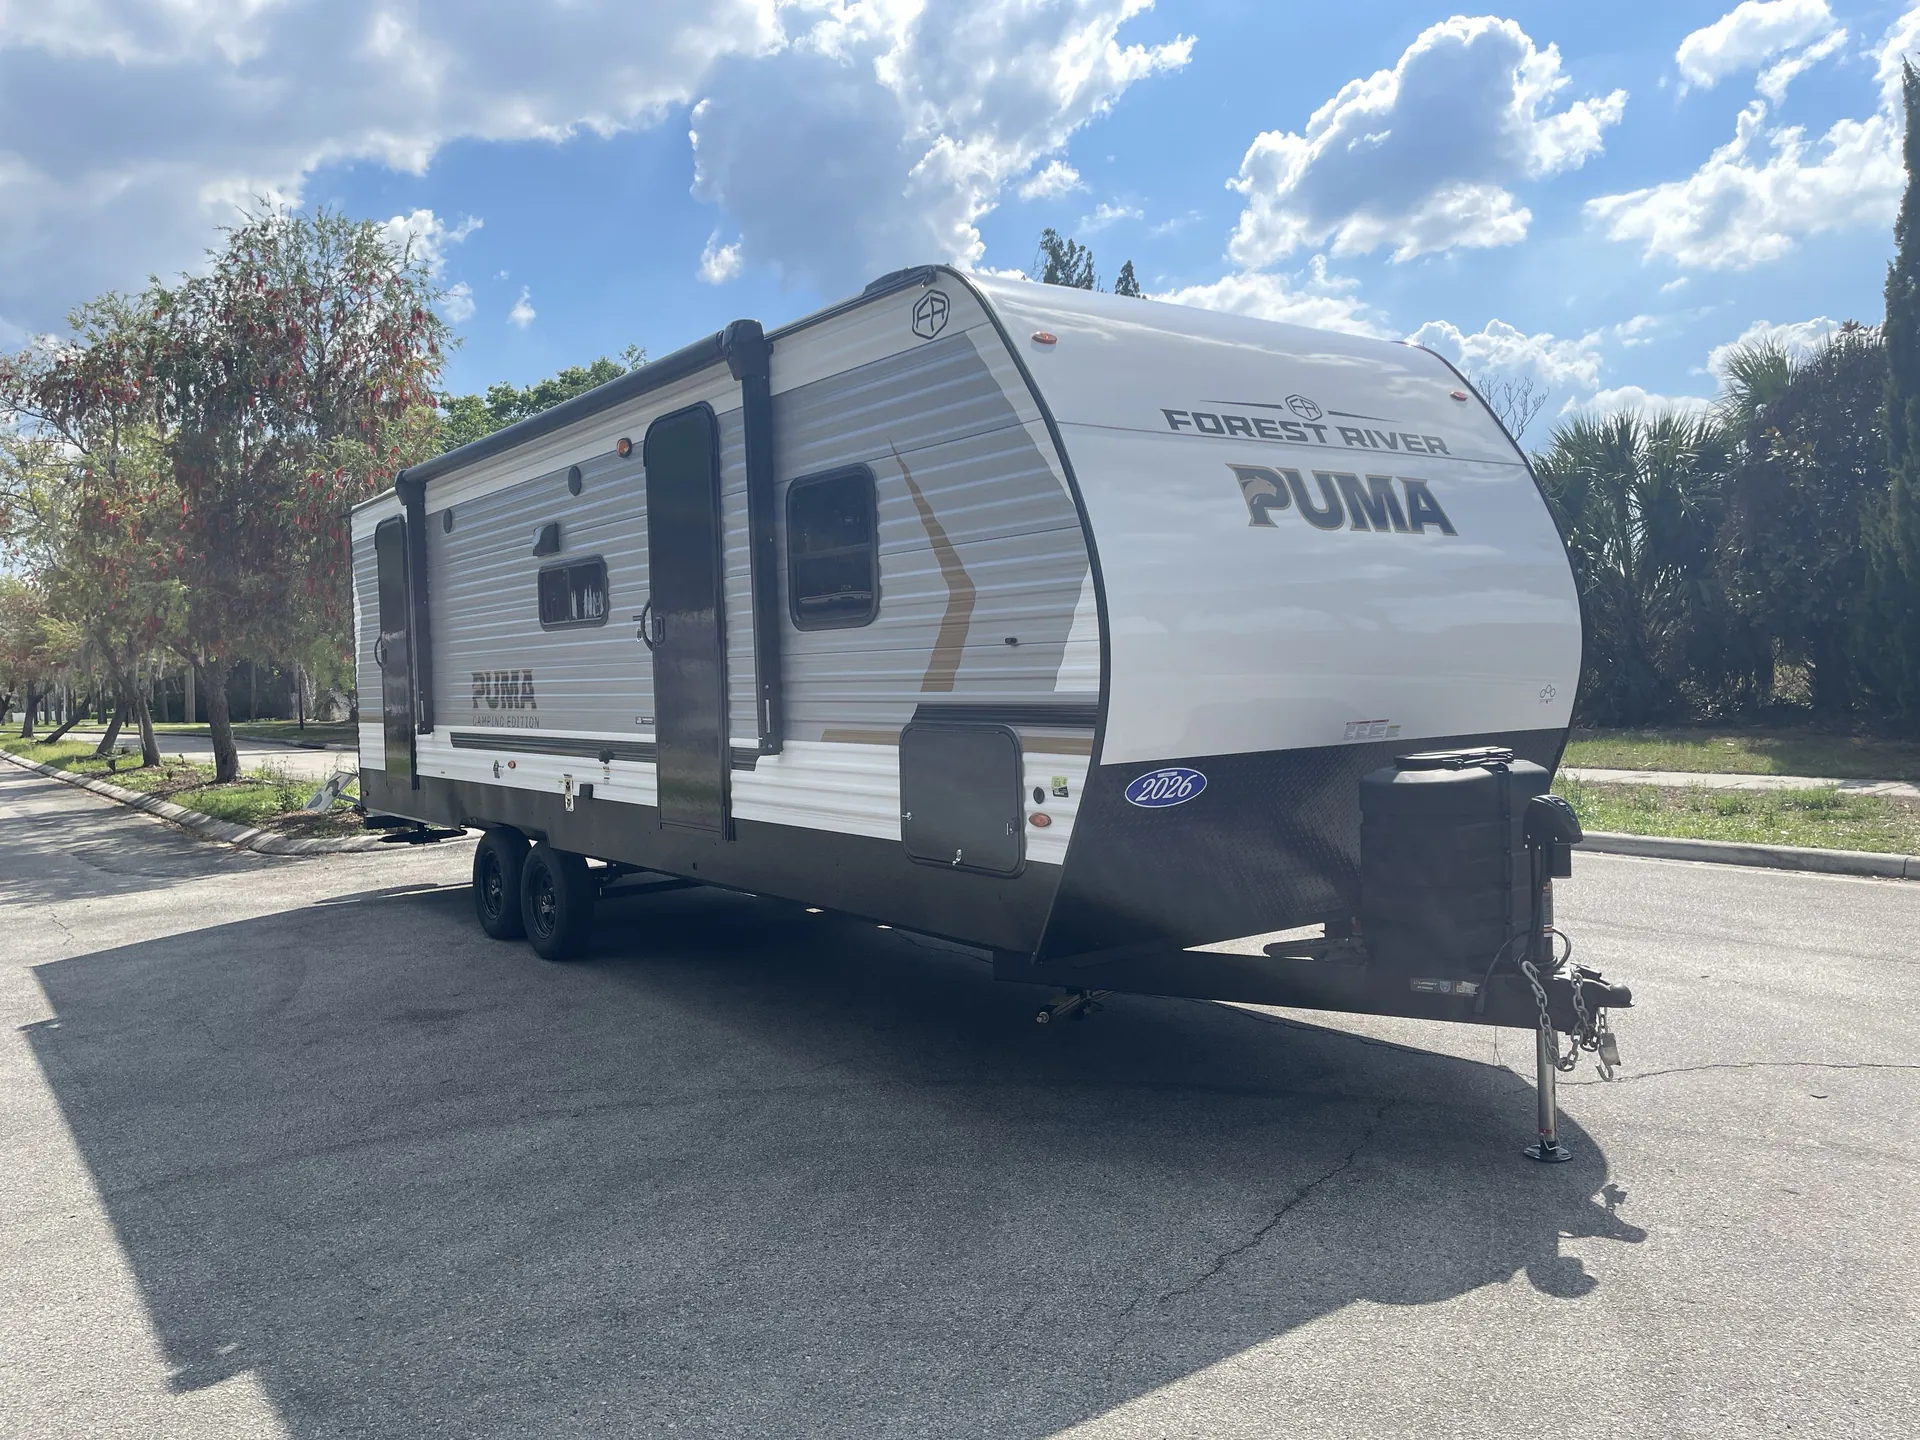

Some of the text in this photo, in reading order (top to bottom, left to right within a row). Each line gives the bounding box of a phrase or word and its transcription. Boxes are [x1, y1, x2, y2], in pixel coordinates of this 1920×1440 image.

[1159, 408, 1452, 456] FOREST RIVER
[1224, 462, 1459, 536] PUMA
[471, 669, 538, 709] PUMA
[472, 715, 540, 729] CAMPING EDITION
[1135, 774, 1198, 802] 2026
